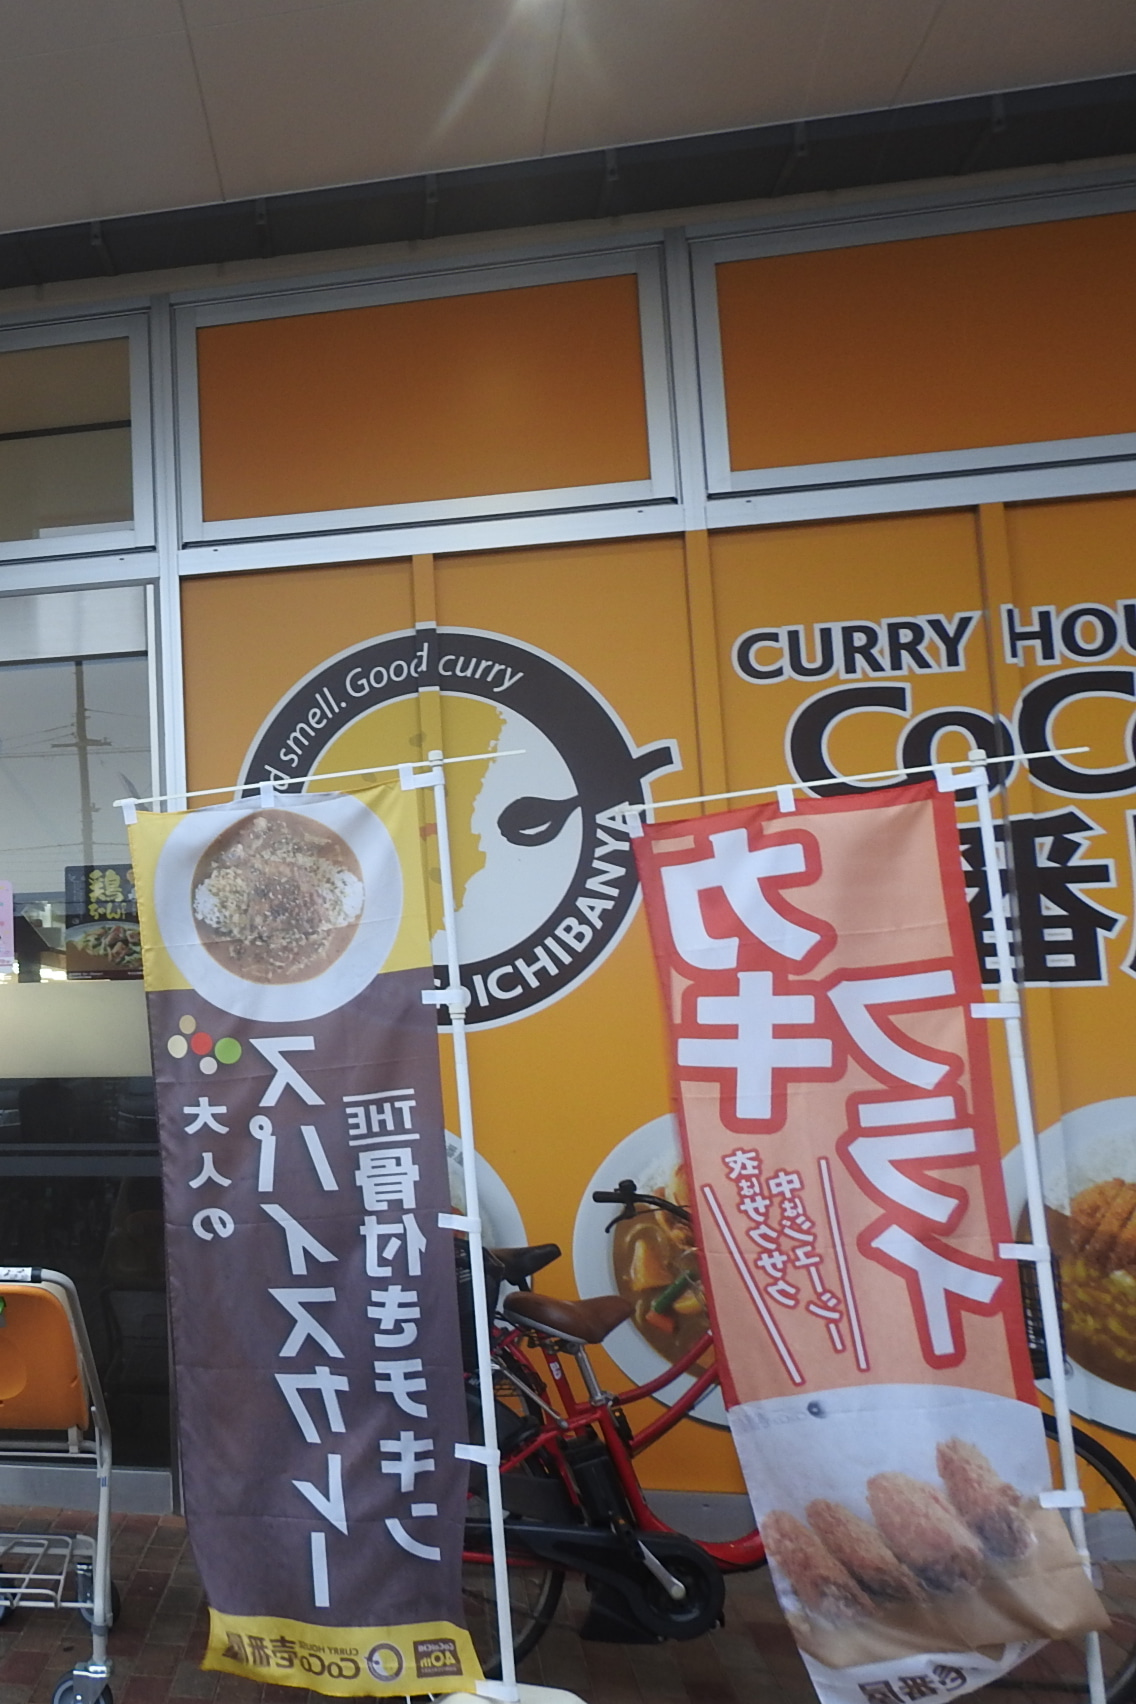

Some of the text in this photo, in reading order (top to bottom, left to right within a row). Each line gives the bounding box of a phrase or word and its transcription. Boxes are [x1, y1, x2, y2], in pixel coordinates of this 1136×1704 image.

[733, 611, 981, 683] CURRY
[279, 642, 524, 767] smell. Good curry
[785, 667, 1136, 804] CoC
[88, 869, 124, 903] 鶏
[88, 903, 120, 920] ちゃん
